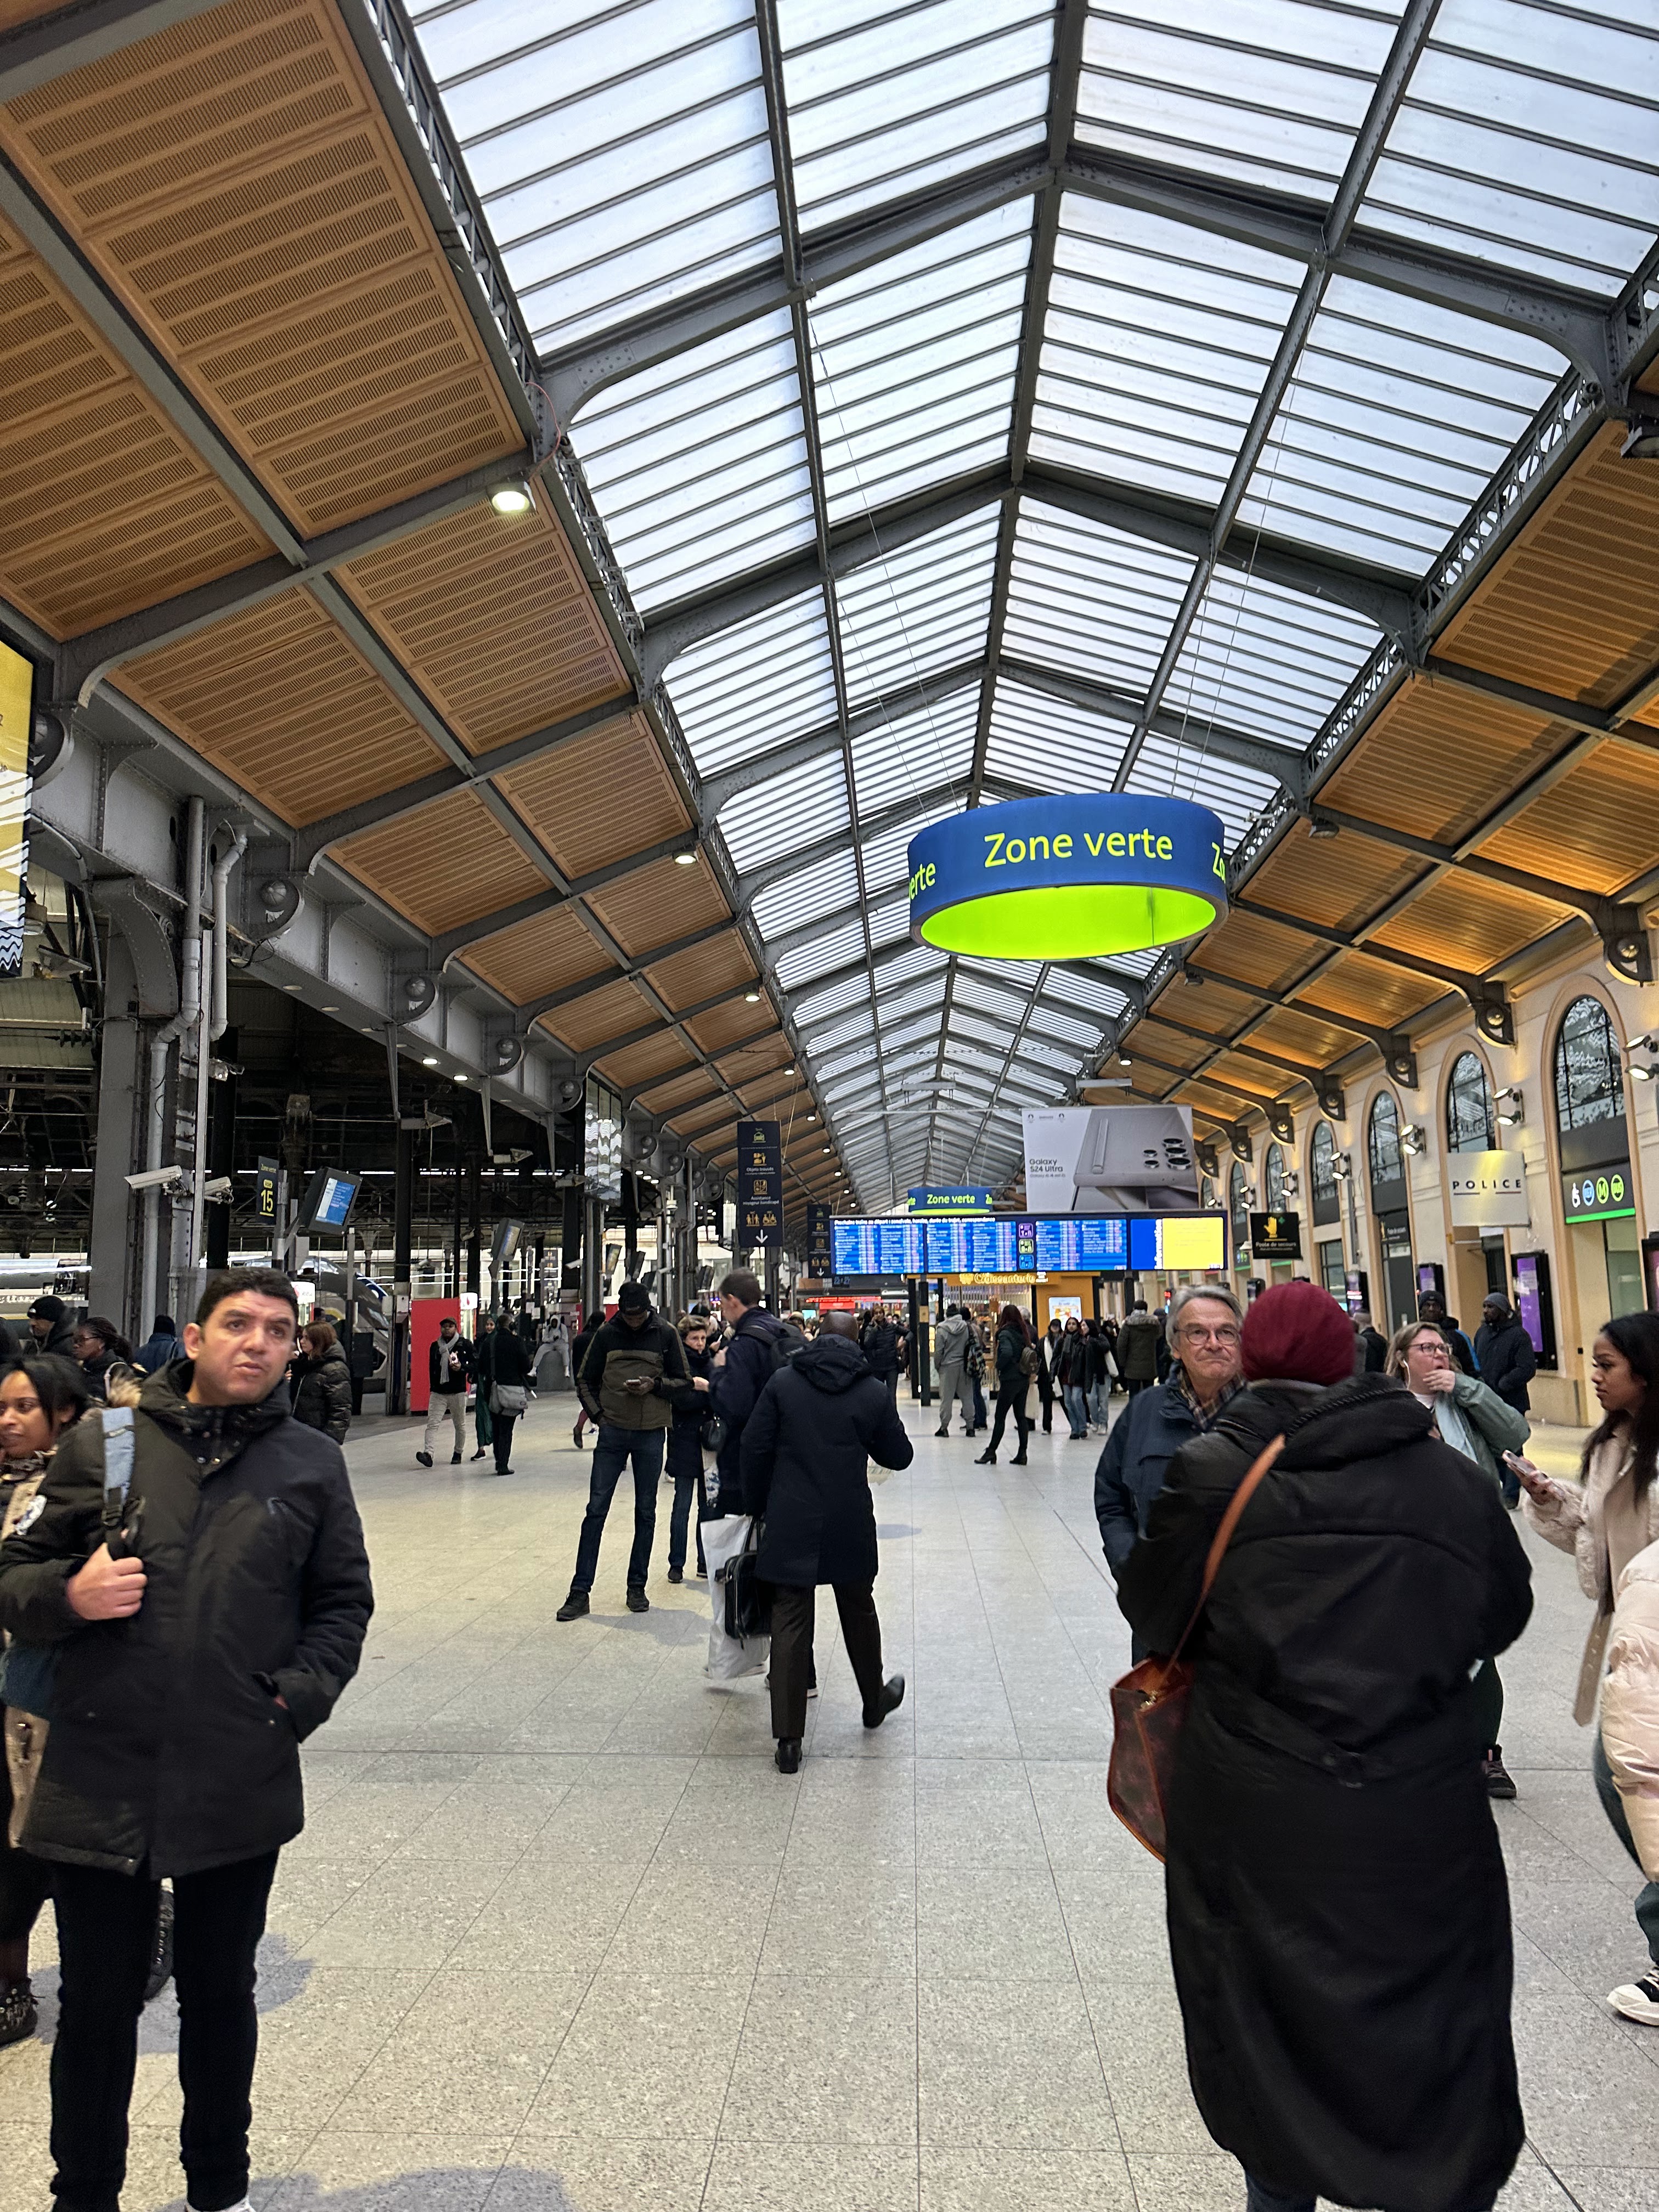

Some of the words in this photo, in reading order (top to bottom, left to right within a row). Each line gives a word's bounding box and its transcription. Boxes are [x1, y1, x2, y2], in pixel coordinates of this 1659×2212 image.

[984, 832, 1073, 868] Zone
[1084, 828, 1173, 860] verte
[1452, 1180, 1521, 1189] POLICE
[261, 1189, 273, 1212] 15
[927, 1194, 950, 1204] Zone
[951, 1194, 975, 1204] verte
